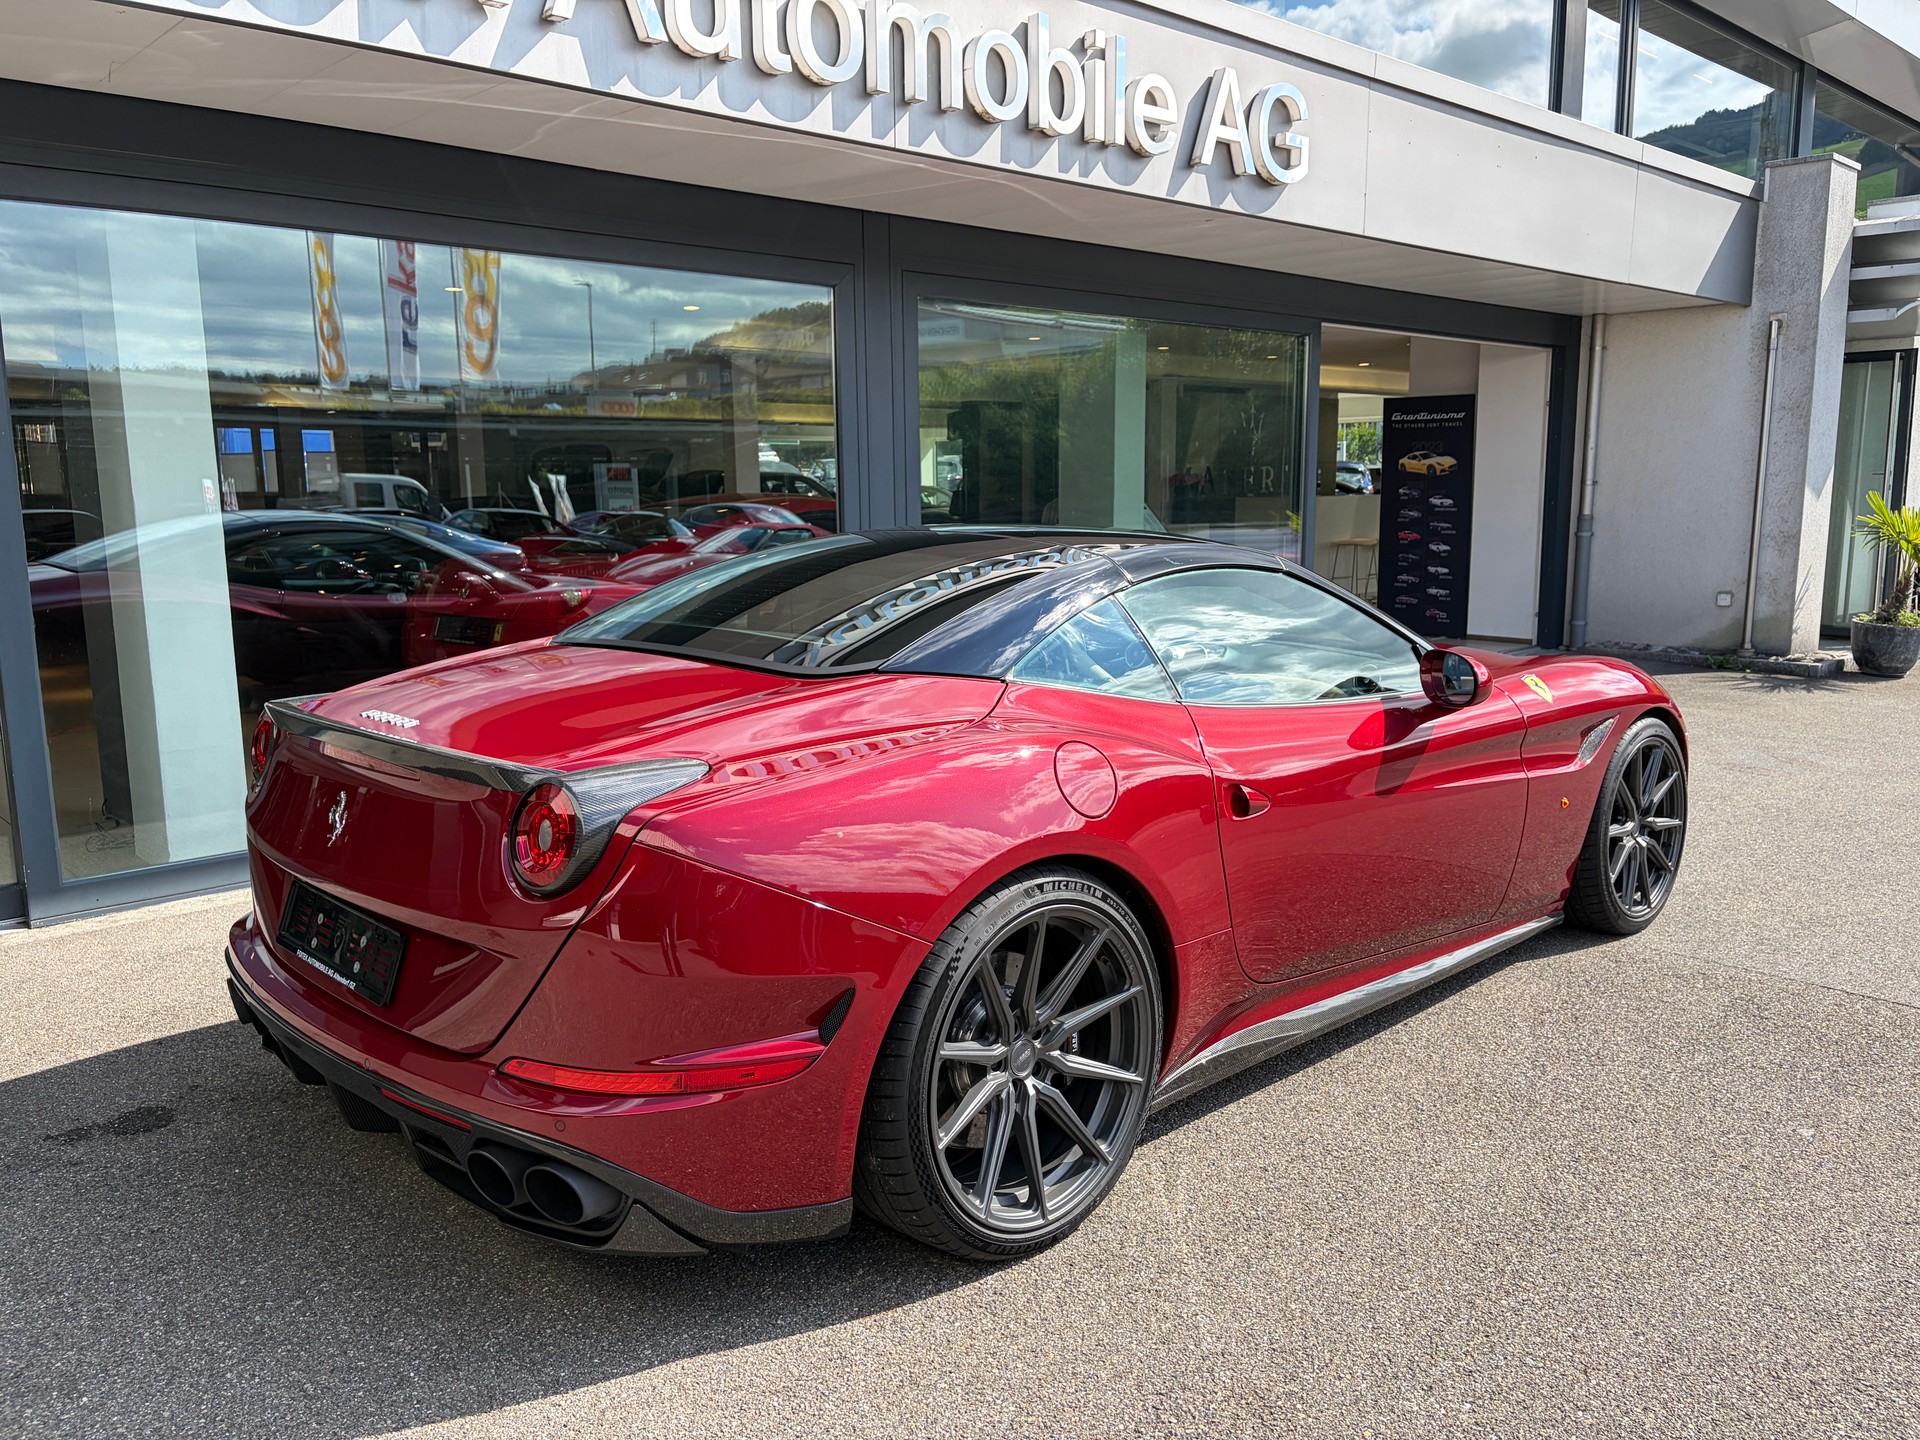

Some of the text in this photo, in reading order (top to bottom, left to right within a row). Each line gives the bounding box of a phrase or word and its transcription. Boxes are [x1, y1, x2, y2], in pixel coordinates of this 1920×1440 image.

[1191, 66, 1310, 186] AG
[1391, 412, 1466, 420] GranTurismo
[1043, 882, 1103, 898] MICHELIN
